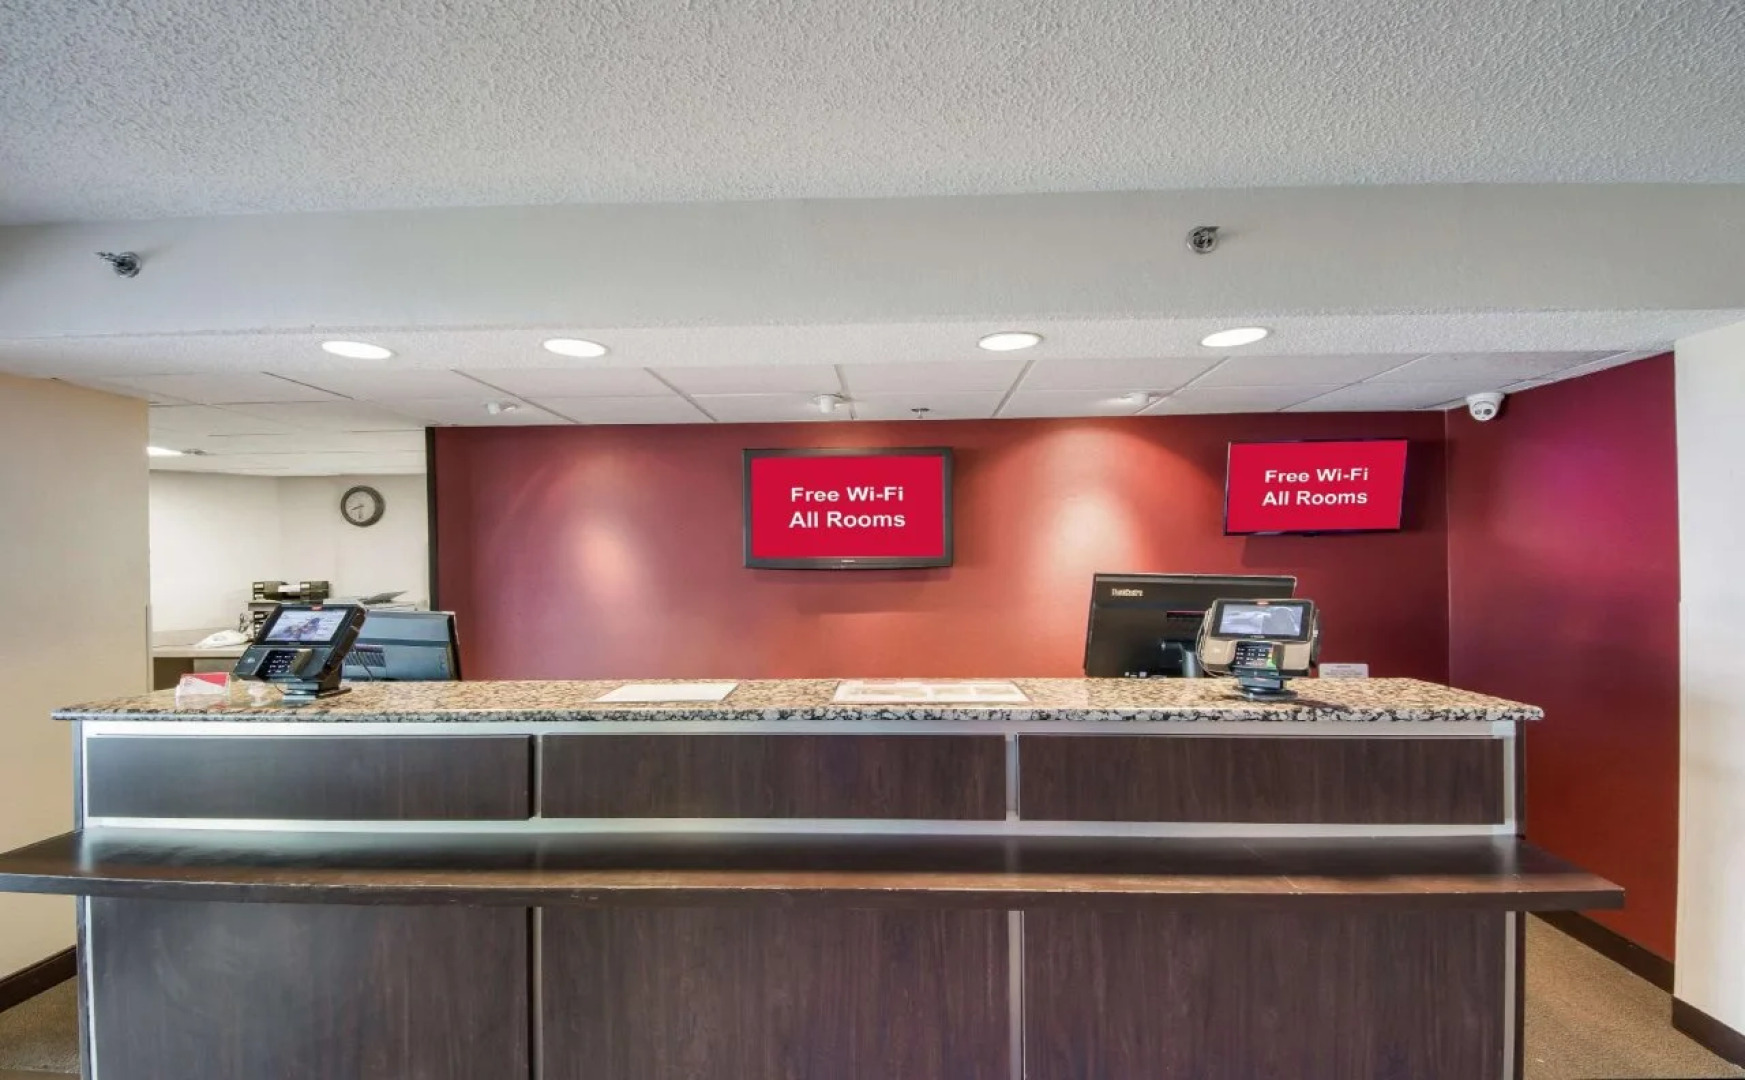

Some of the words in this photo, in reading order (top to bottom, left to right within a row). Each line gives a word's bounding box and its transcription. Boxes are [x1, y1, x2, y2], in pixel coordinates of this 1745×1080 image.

[1264, 469, 1310, 483] Free
[1316, 467, 1369, 482] Wi-Fi
[790, 486, 840, 502] Free
[846, 486, 904, 502] Wi-Fi
[1261, 490, 1290, 506] All
[1296, 490, 1368, 506] Rooms
[788, 510, 819, 528] All
[826, 510, 906, 528] Rooms
